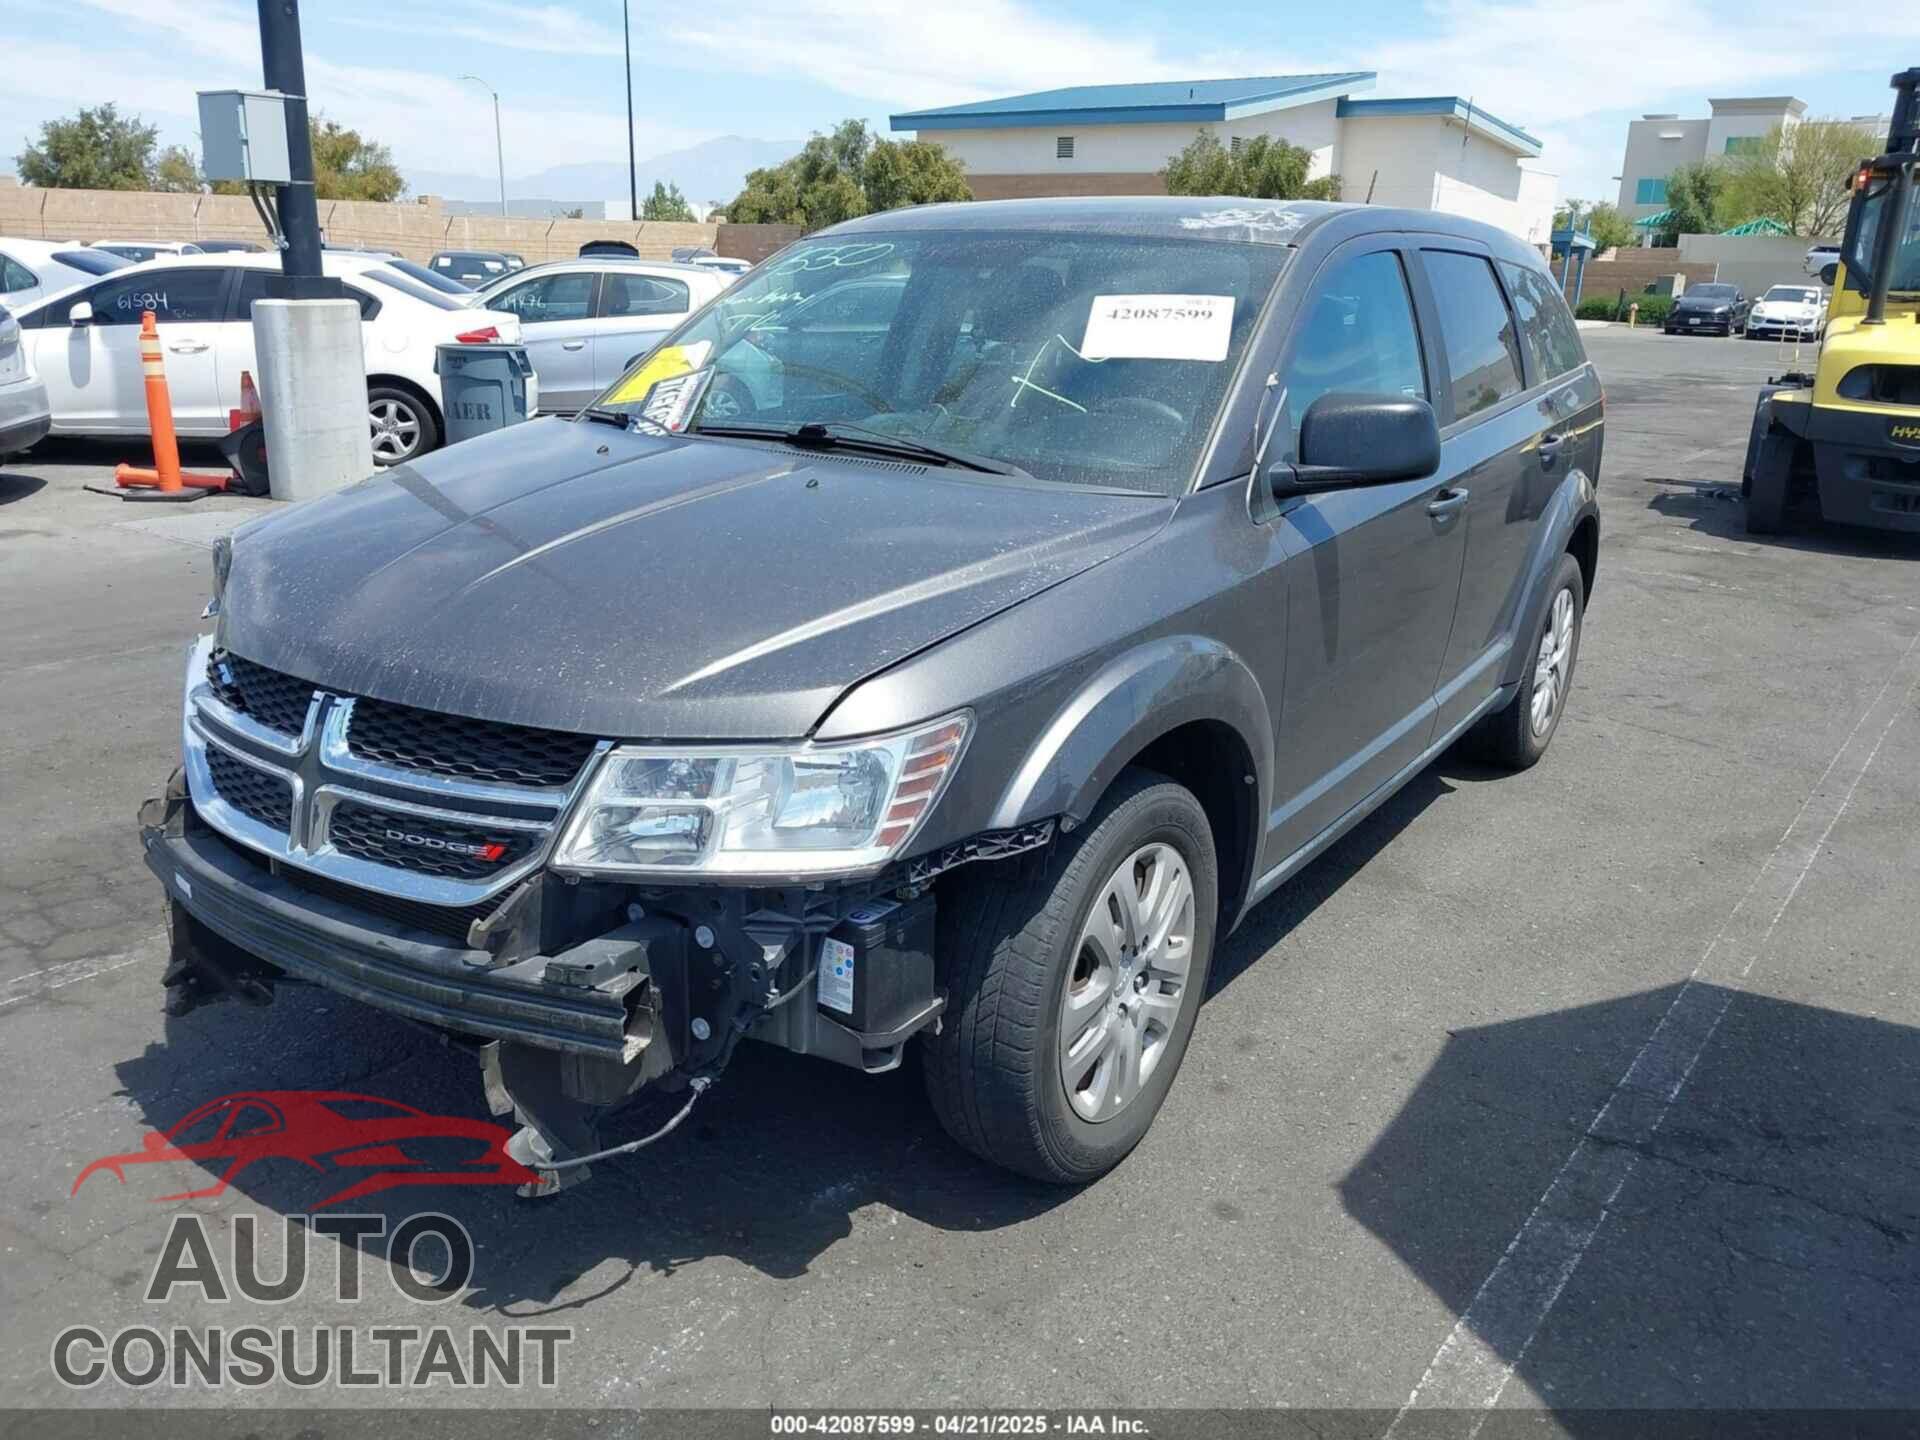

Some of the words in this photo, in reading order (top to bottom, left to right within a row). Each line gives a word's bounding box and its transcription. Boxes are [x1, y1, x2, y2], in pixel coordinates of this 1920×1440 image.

[116, 291, 168, 311] 61584
[1106, 308, 1213, 320] 42087599
[386, 829, 489, 857] DODGE
